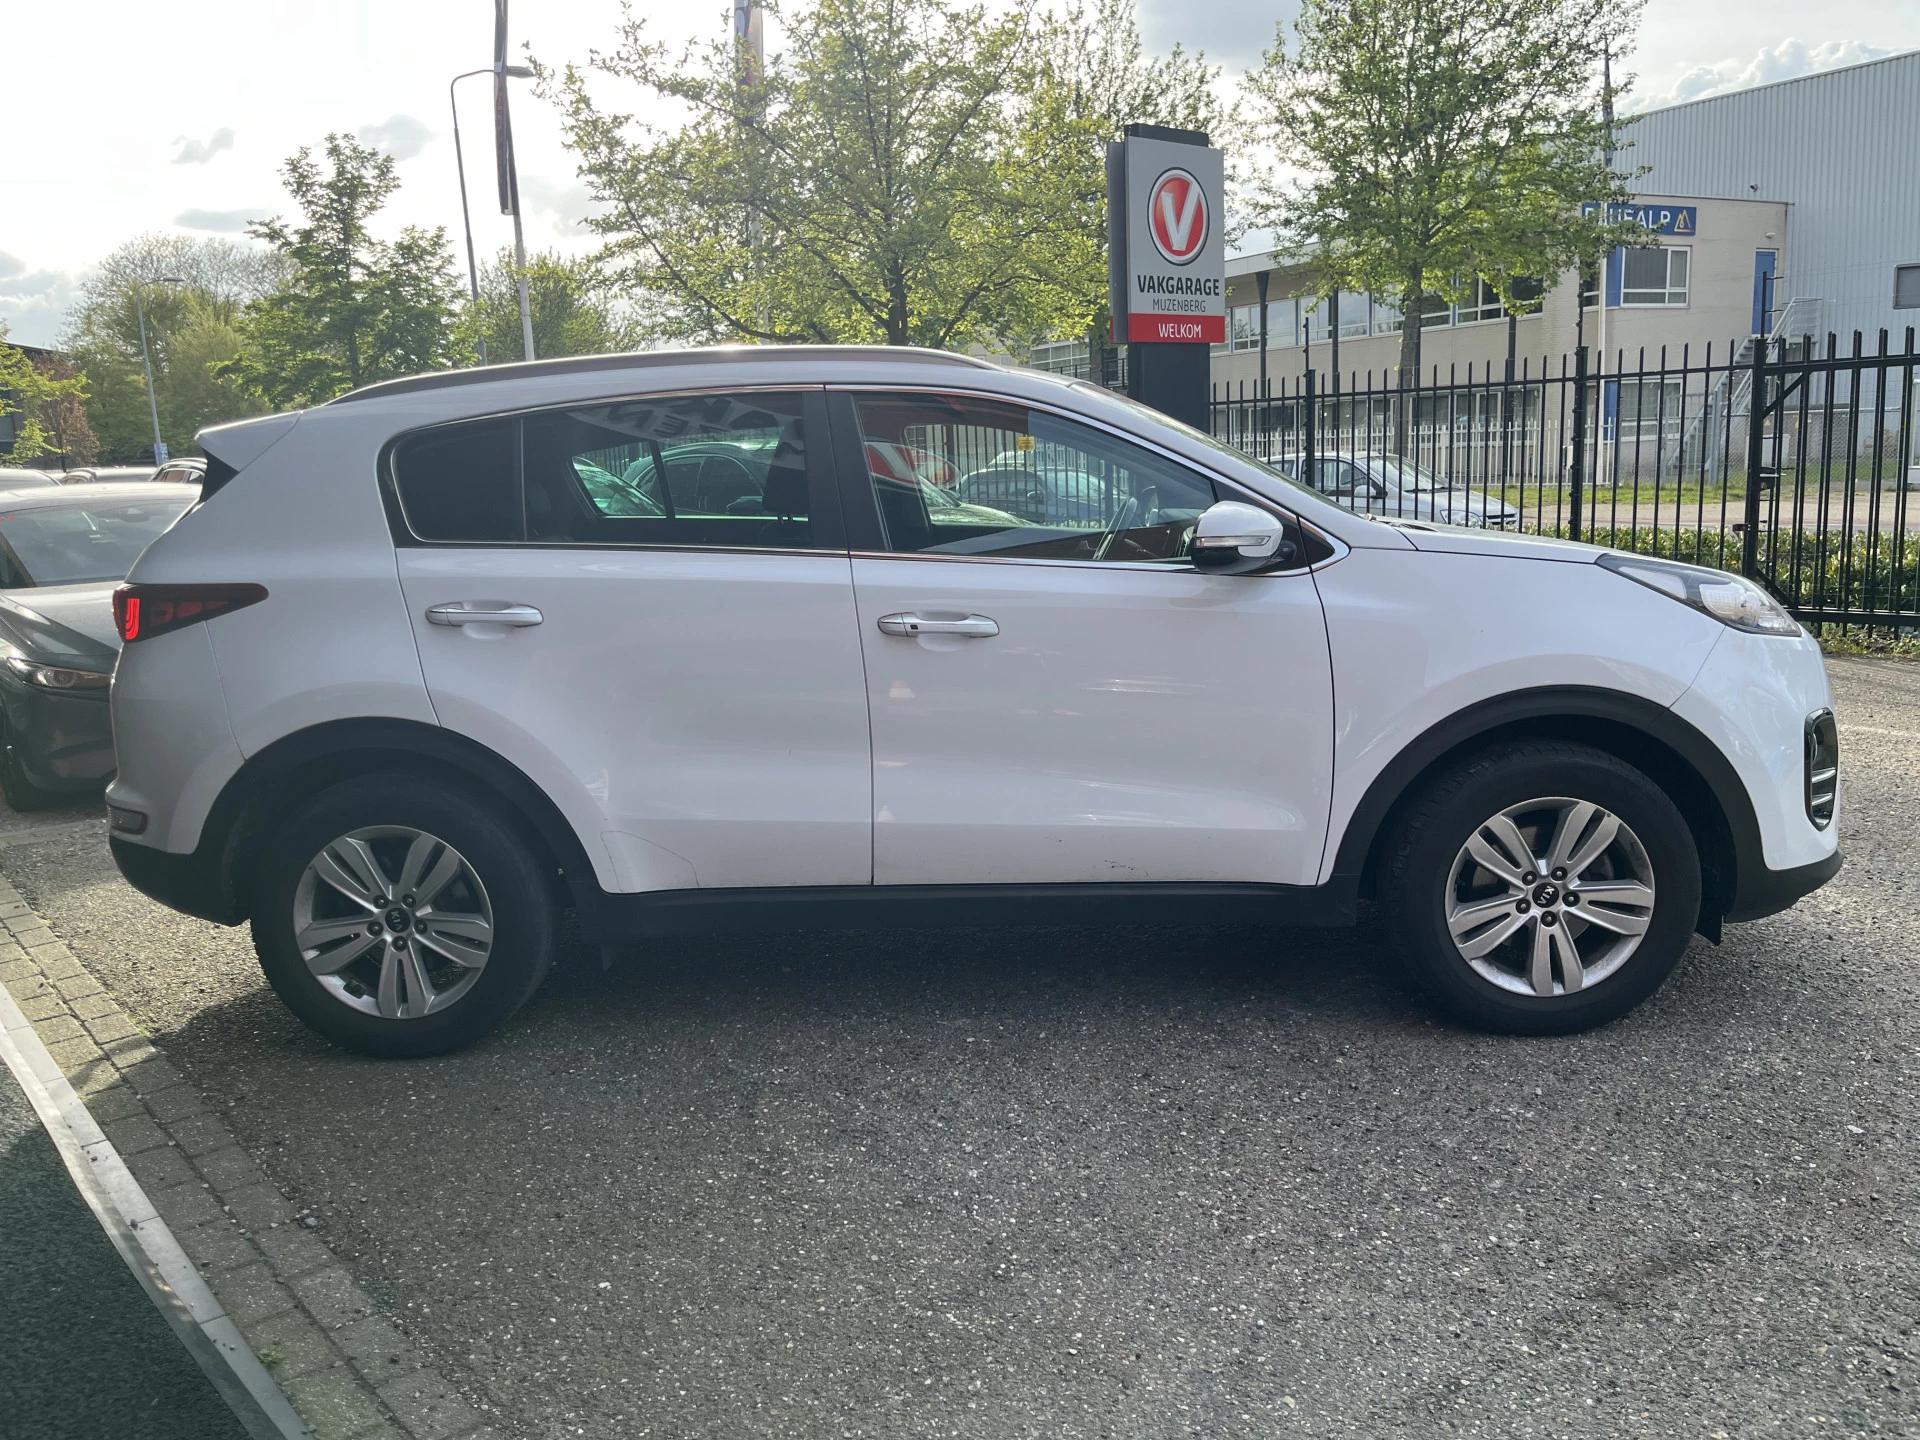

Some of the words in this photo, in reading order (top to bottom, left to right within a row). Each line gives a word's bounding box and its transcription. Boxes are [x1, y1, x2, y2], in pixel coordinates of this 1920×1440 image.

[1161, 178, 1201, 251] V
[1137, 274, 1220, 297] VAKGARAGE
[1153, 298, 1206, 312] MUZENBERG
[1158, 323, 1202, 338] WELKOM
[1538, 886, 1555, 904] KIA
[391, 911, 403, 930] KIA
